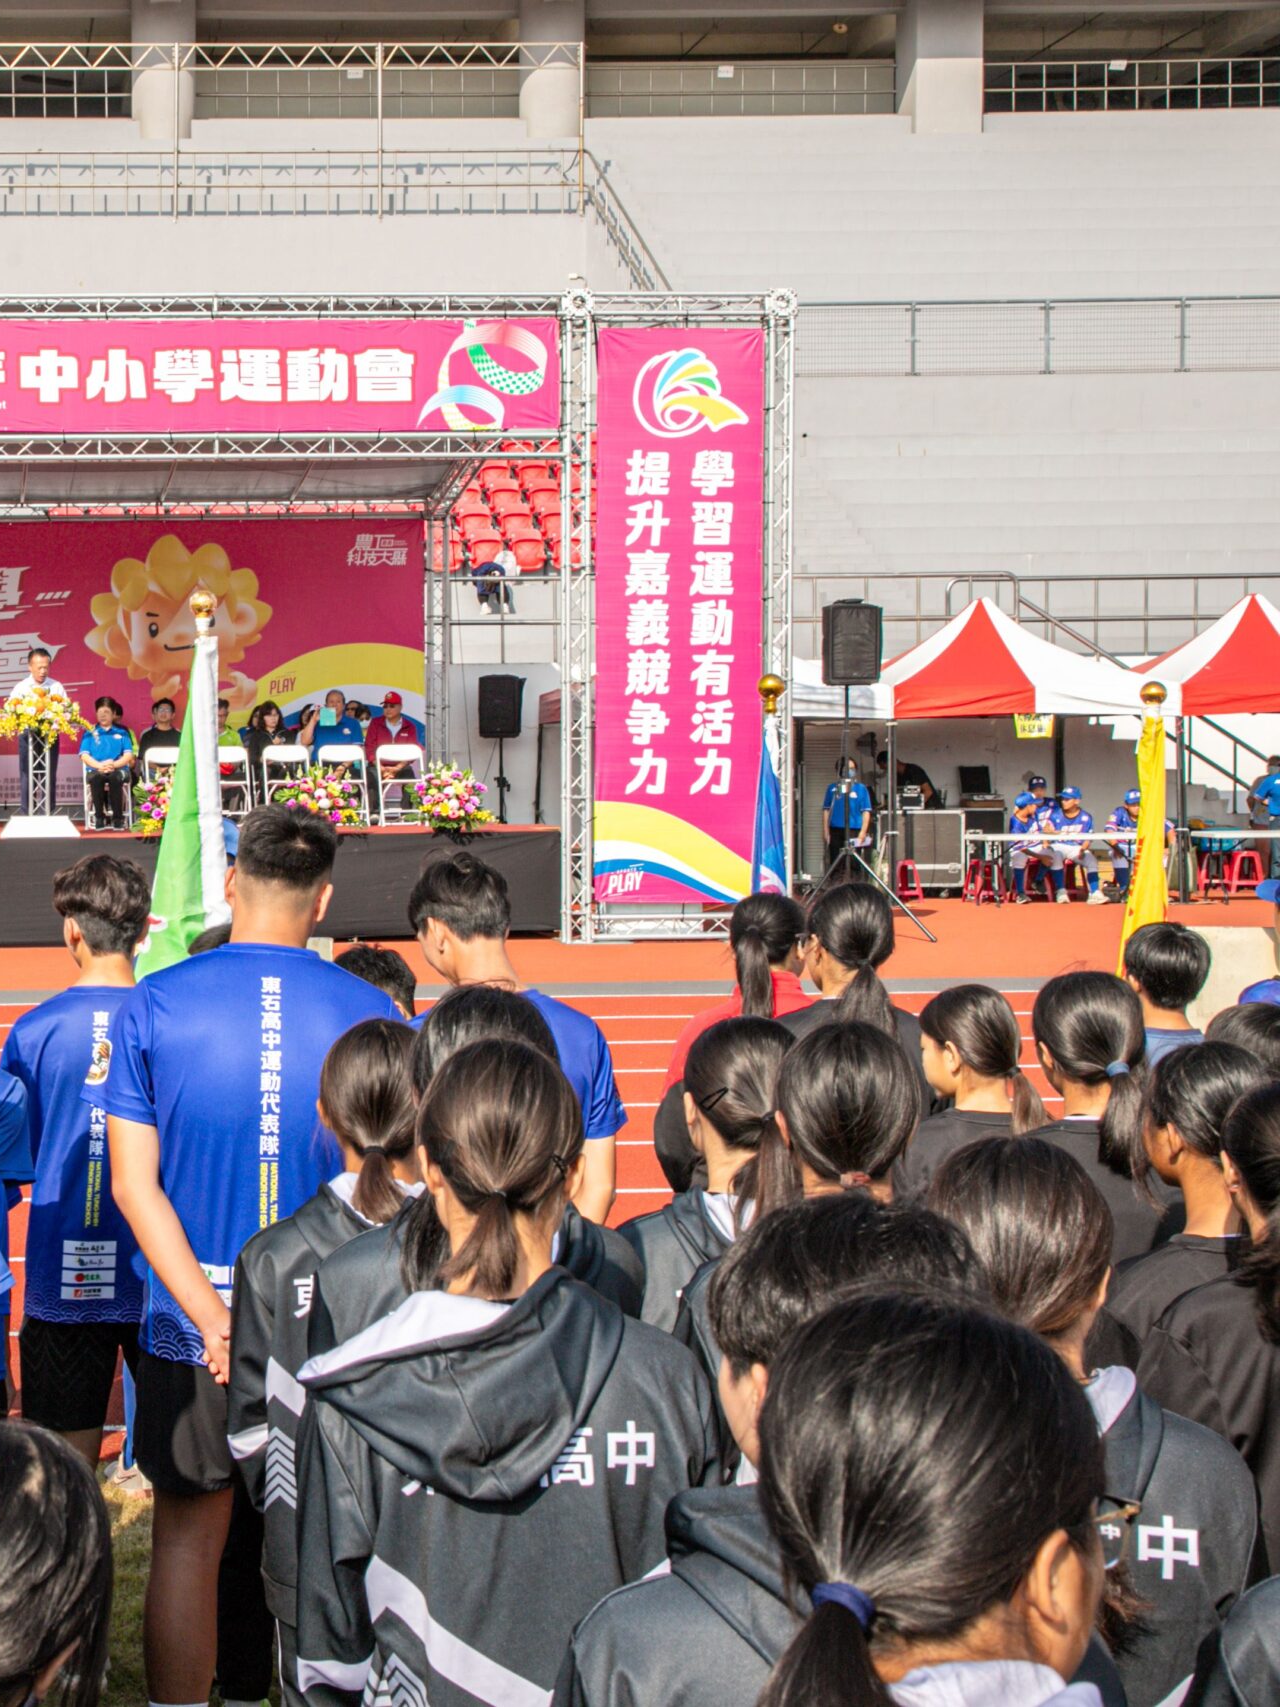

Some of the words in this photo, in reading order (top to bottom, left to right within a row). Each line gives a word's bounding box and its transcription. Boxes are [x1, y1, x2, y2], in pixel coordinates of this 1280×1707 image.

[20, 348, 415, 403] 中小學運動會
[688, 449, 735, 796] 學習運動有活力
[269, 676, 297, 695] PLAY
[608, 871, 644, 894] PLAY
[260, 976, 282, 1156] 東石高中運動代表隊
[1137, 1514, 1199, 1580] 中
